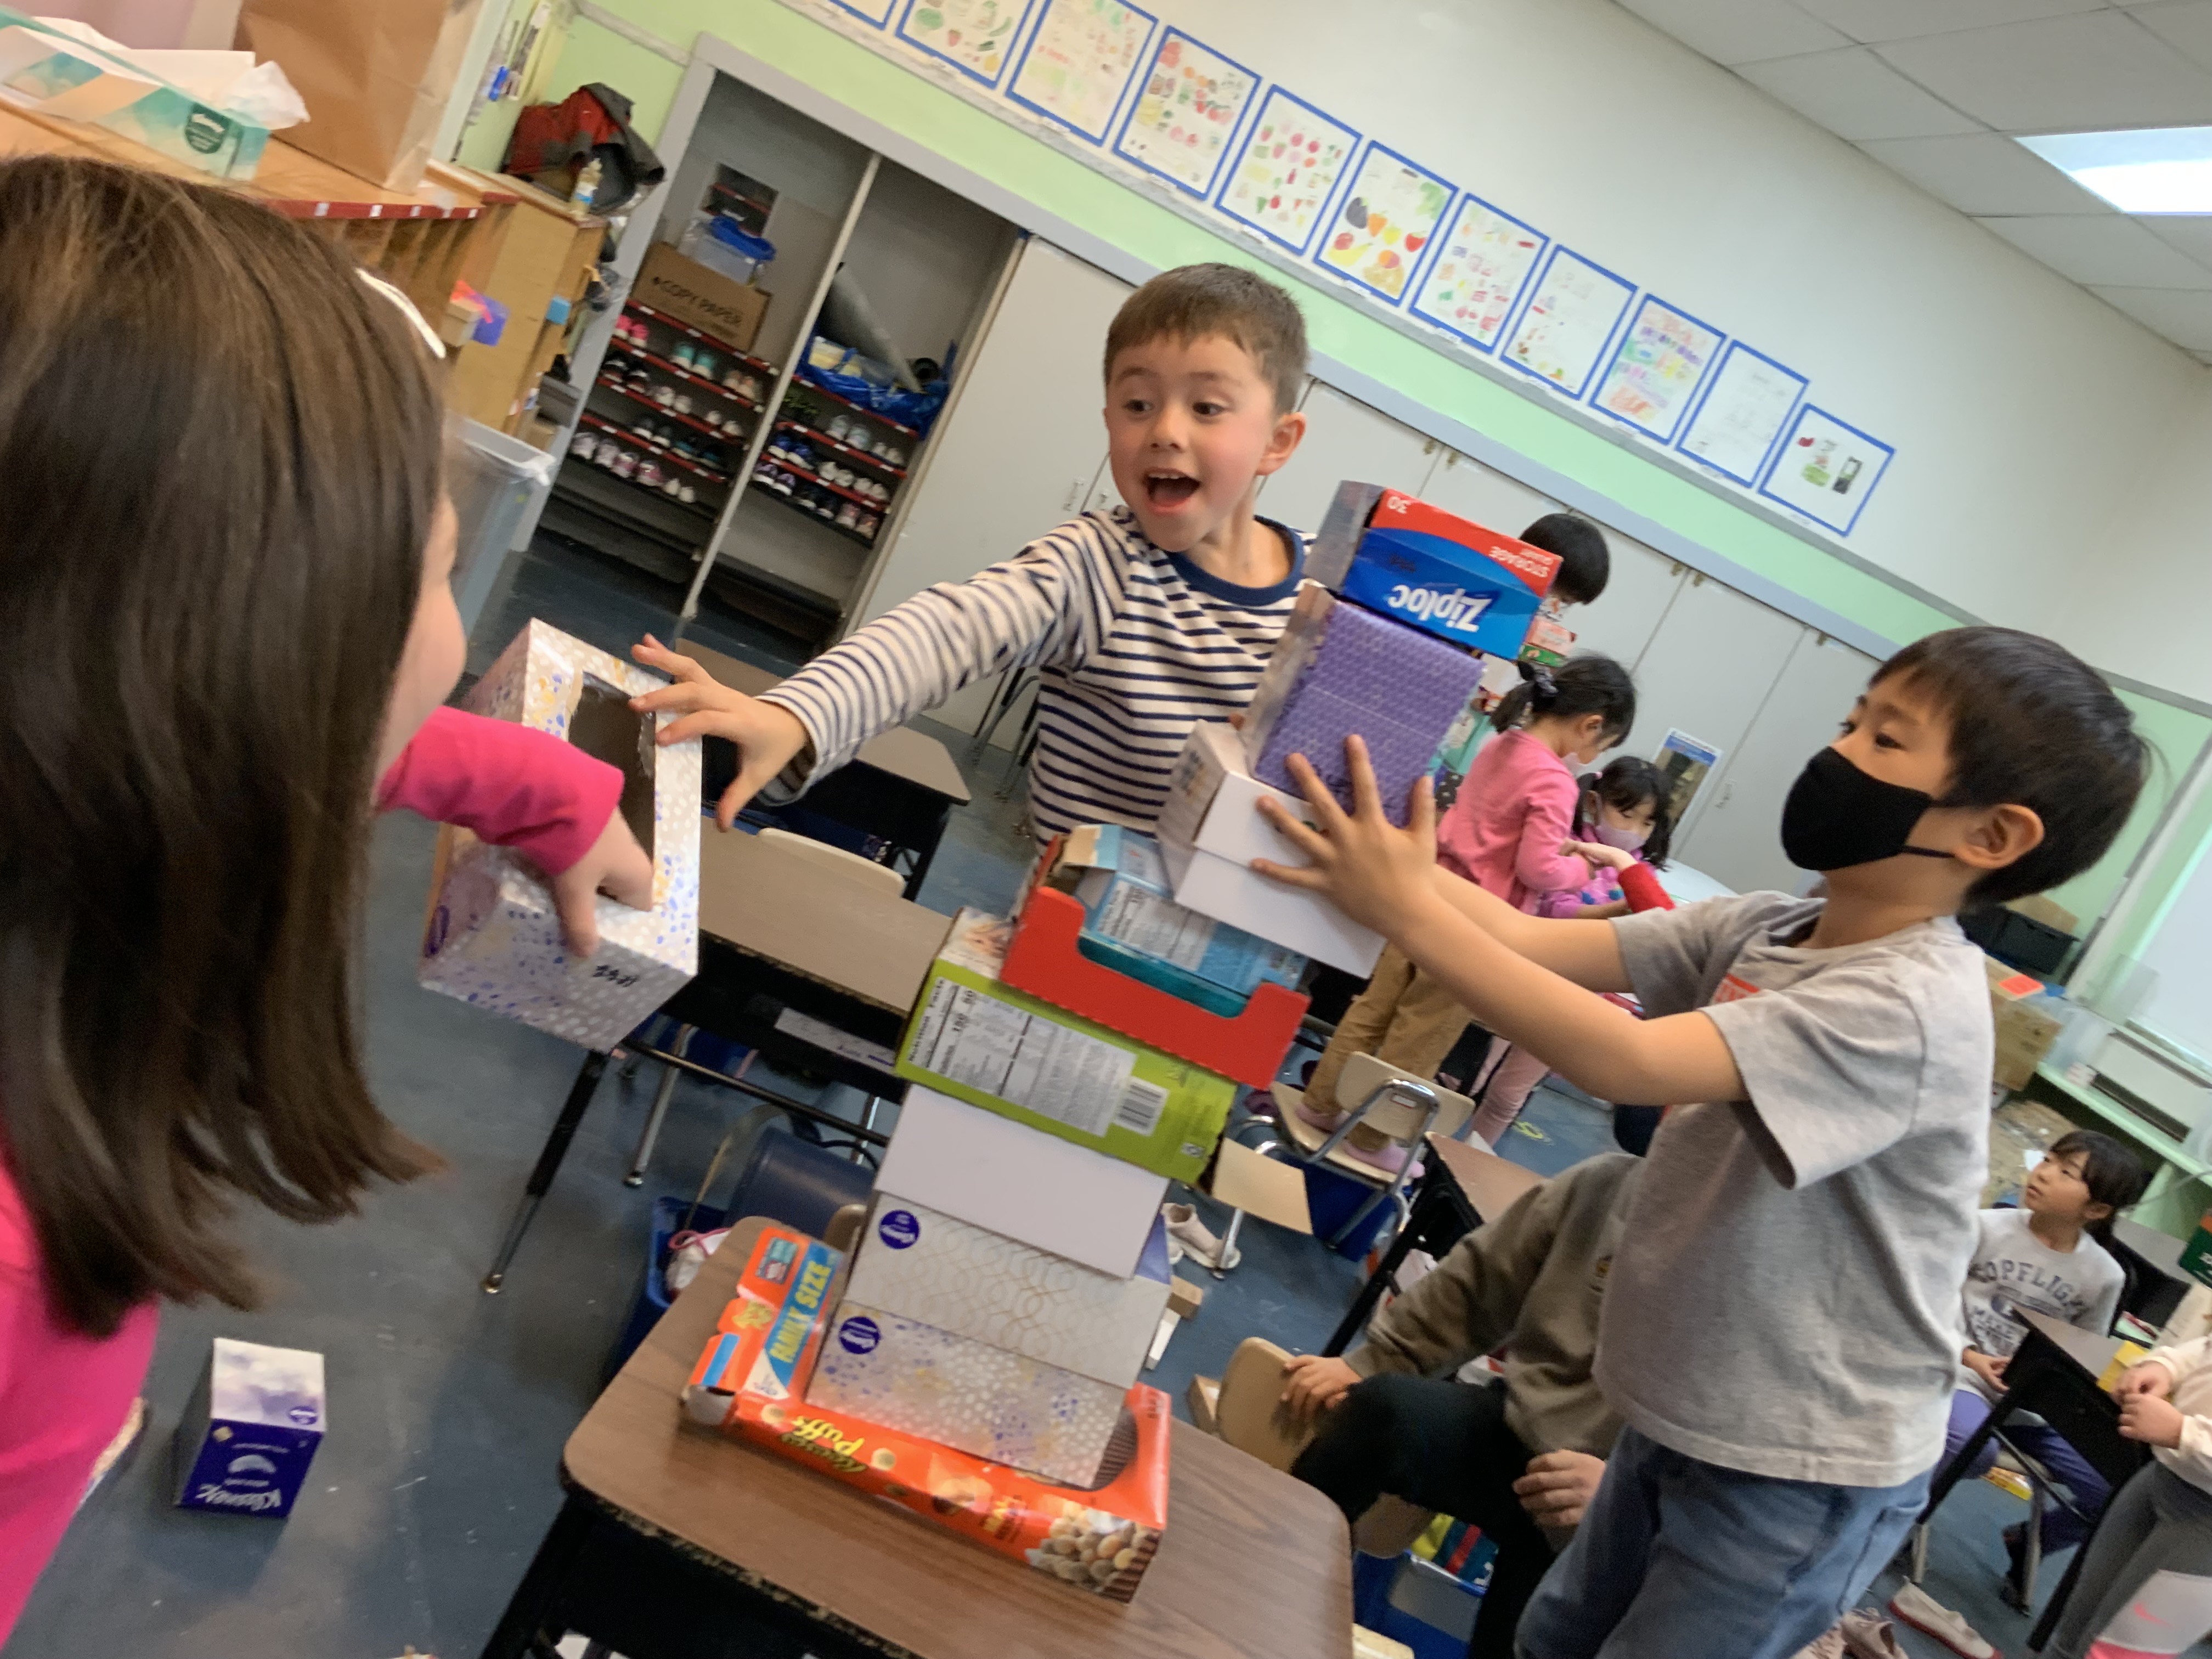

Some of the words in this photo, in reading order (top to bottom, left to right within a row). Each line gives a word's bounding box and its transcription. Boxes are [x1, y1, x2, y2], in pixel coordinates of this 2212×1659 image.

[1387, 495, 1412, 515] 30
[1488, 546, 1550, 578] STORAGE
[1387, 584, 1492, 633] Ziploc
[794, 1260, 832, 1309] SIZE
[792, 1414, 865, 1457] Puffs
